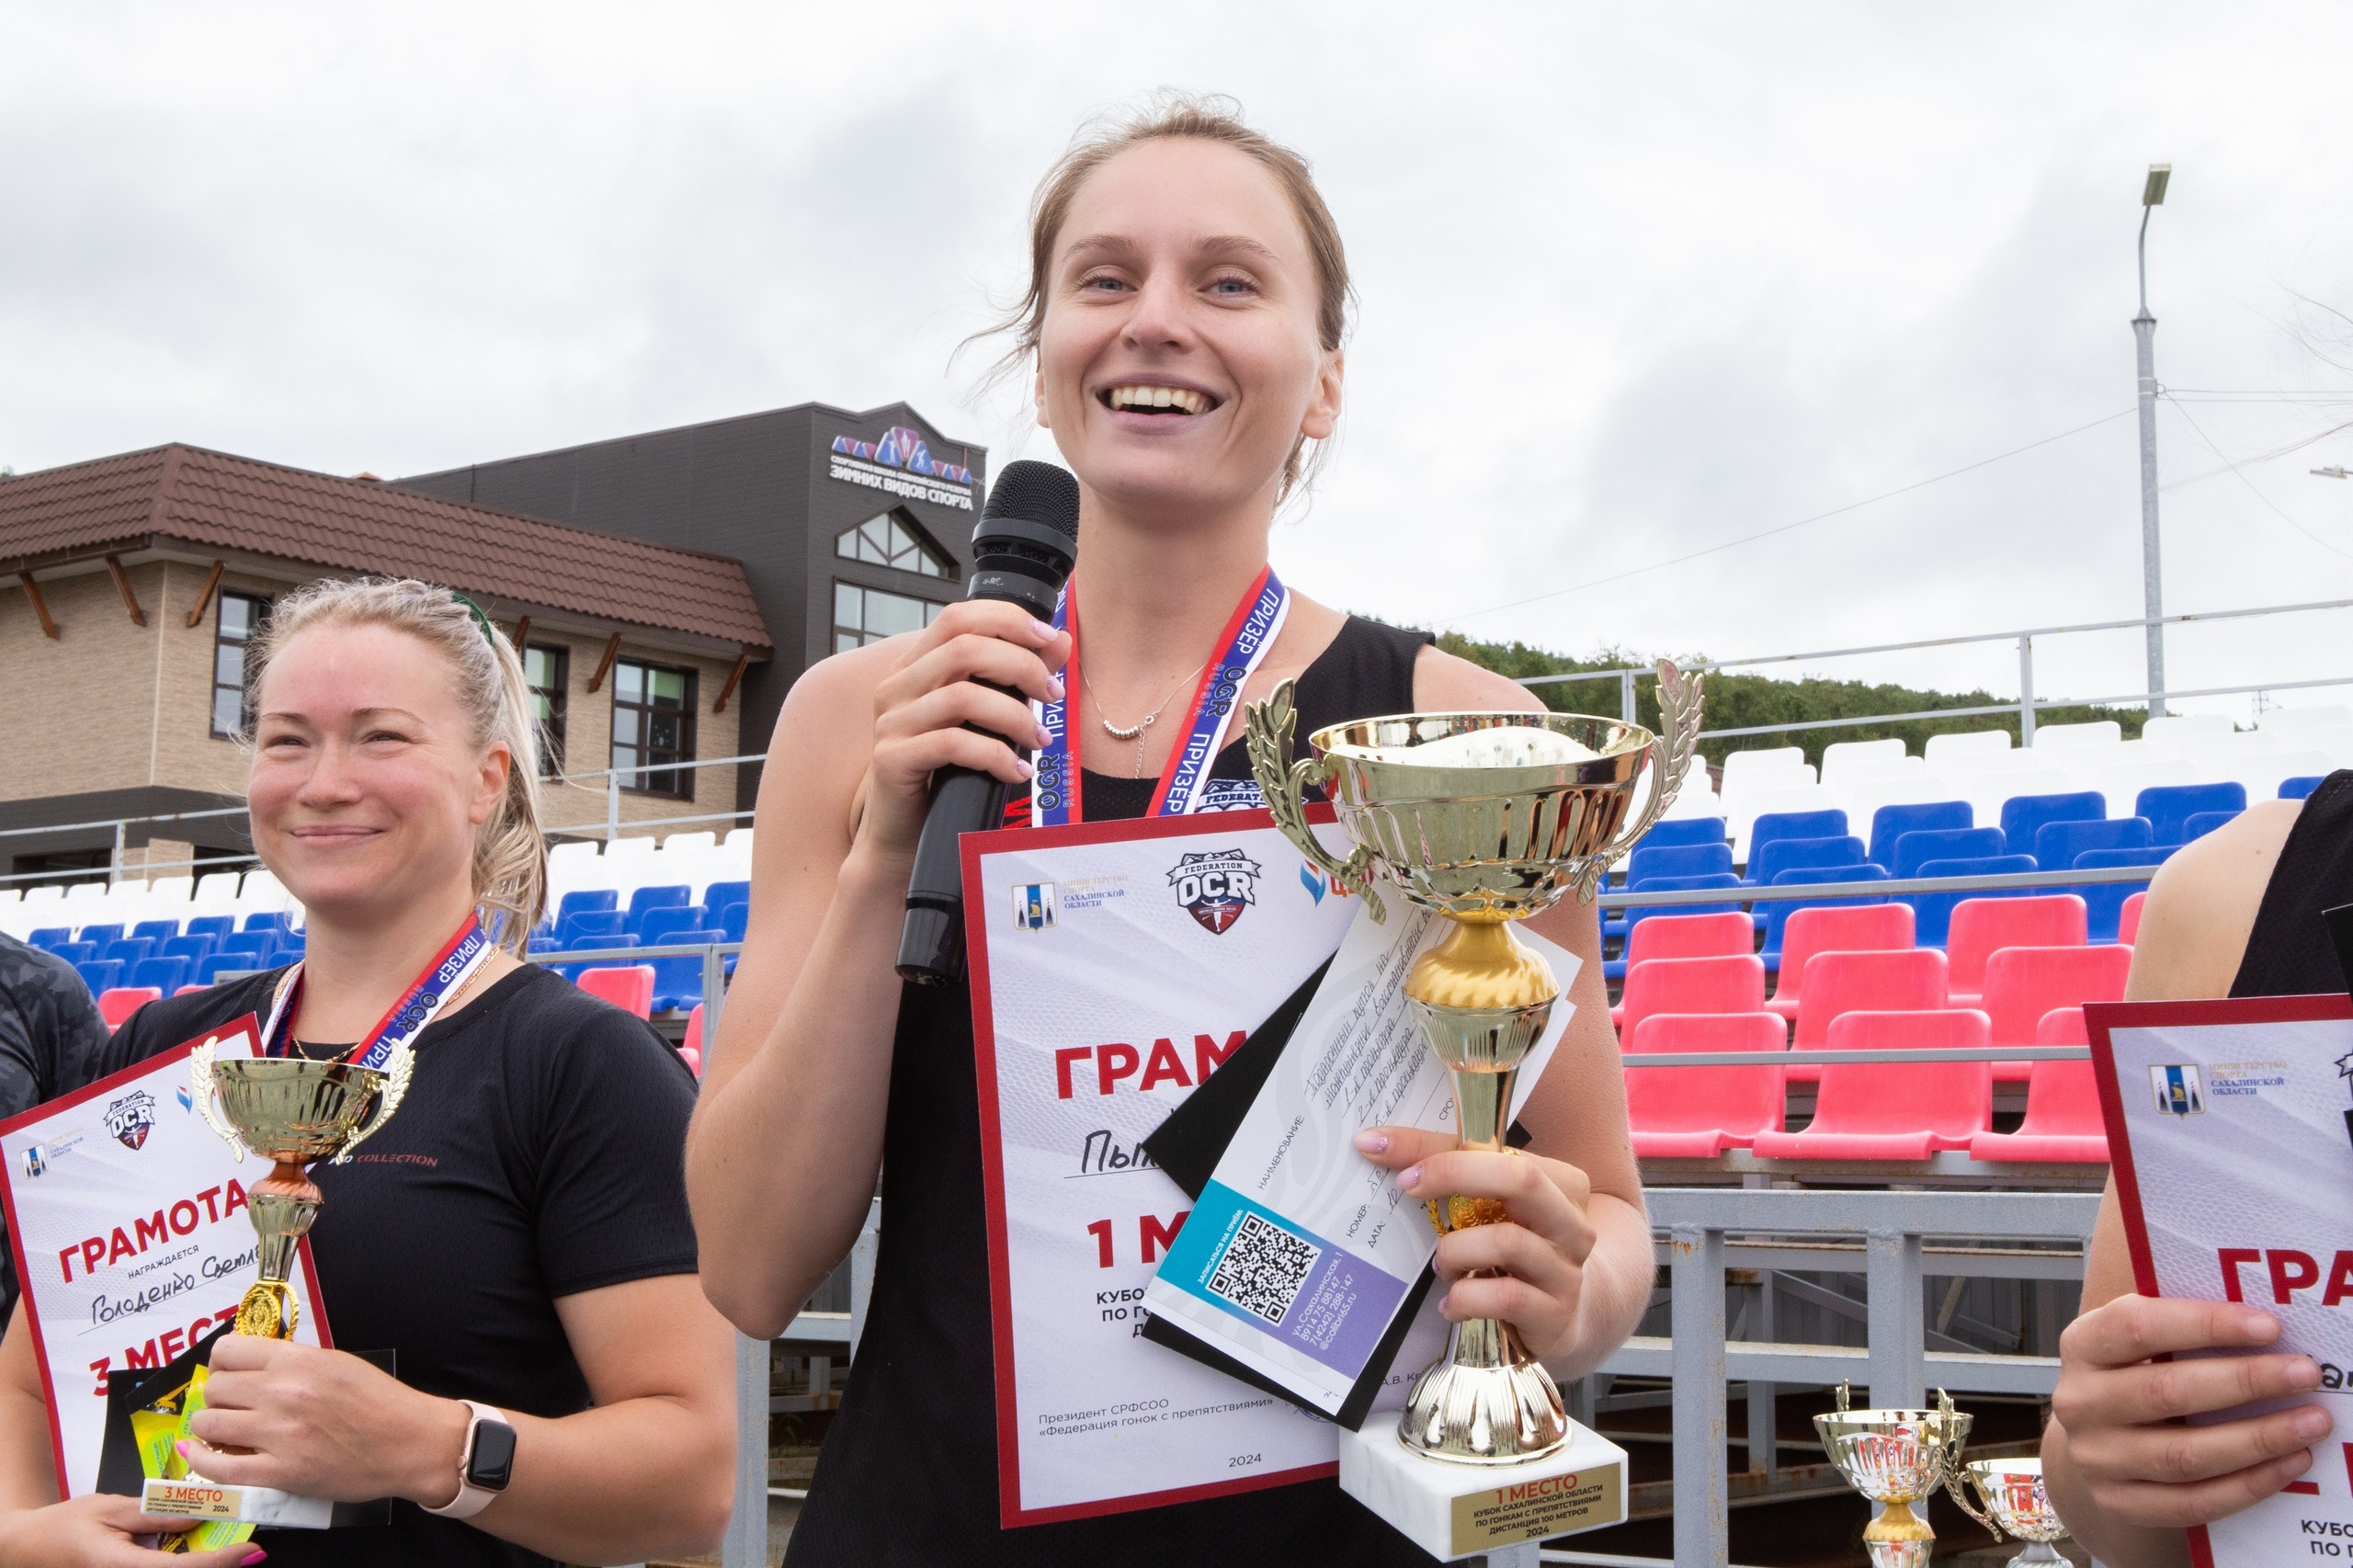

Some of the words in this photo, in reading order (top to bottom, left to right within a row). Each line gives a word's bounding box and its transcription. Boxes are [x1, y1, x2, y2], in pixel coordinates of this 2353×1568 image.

[829, 464, 882, 489] ЗИМНИХ
[882, 478, 926, 499] ВИДОВ
[927, 491, 973, 511] СПОРТА
[1236, 587, 1280, 654] ПРИЗЁР
[1193, 663, 1225, 716] RUSSIA
[1063, 751, 1074, 807] RUSSIA
[1166, 733, 1211, 813] ПРИЗЁР
[1206, 793, 1264, 804] FEDERAT
[1063, 875, 1128, 887] МИНИСТЕРСТВО
[1185, 862, 1243, 874] FEDERATION
[1063, 886, 1095, 894] СПОРТА
[1063, 889, 1125, 902] САХАЛИНСКОЙ
[1064, 900, 1102, 910] ОБЛАСТИ
[1177, 871, 1255, 906] OCR
[438, 935, 480, 983] ПРИЗЁР
[1054, 1029, 1246, 1100] ГРАМ
[2211, 1077, 2285, 1087] САХАЛИНСКОЙ
[2212, 1087, 2257, 1096] ОБЛАСТИ
[110, 1104, 155, 1138] OCR
[112, 1098, 144, 1116] FEDERATION
[357, 1154, 438, 1167] COLLECTION
[1257, 1115, 1305, 1190] НАИМЕНОВАНИЕ:
[59, 1177, 249, 1284] ГРАМОТА
[1347, 1203, 1371, 1238] НОМЕР:
[1368, 1221, 1386, 1248] ДАТА:
[1087, 1219, 1113, 1268] 1
[1198, 1242, 1224, 1284] ЗАПИСАТЬСЯ
[1221, 1233, 1230, 1244] НА
[128, 1244, 199, 1279] НАГРАЖДАЕТСЯ
[92, 1272, 194, 1325] Голоденко
[1097, 1287, 1147, 1304] КУБО
[1301, 1317, 1318, 1341] 8914
[1313, 1305, 1325, 1318] 75
[1321, 1276, 1340, 1304] 88147
[1310, 1312, 1335, 1346] 7(4242)
[1329, 1274, 1353, 1311] 288-147
[1102, 1308, 1128, 1322] ПО
[1320, 1293, 1357, 1350] @colibri65.ru
[89, 1357, 110, 1397] 3
[1039, 1407, 1107, 1425] Президент
[1110, 1398, 1169, 1415] СРФСОО
[1039, 1419, 1118, 1437] «Федерация
[1121, 1415, 1157, 1426] гонок
[1161, 1412, 1168, 1421] с
[1172, 1398, 1274, 1419] препятствиями»
[1228, 1453, 1262, 1468] 2024
[165, 1486, 173, 1498] 3
[176, 1487, 222, 1502] МЕСТО
[1473, 1506, 1501, 1518] КУБОК
[1503, 1491, 1563, 1512] САХАЛИНСКОЙ
[1565, 1484, 1603, 1498] ОБЛАСТИ
[1495, 1489, 1504, 1505] 1
[1509, 1474, 1577, 1502] МЕСТО
[212, 1505, 229, 1513] 2024
[1475, 1518, 1488, 1528] ПО
[1490, 1512, 1523, 1526] ГОНКАМ
[1524, 1508, 1530, 1517] С
[1532, 1494, 1601, 1516] ПРЕПЯТСТВИЯМИ
[1489, 1517, 1540, 1536] ДИСТАНЦИЯ
[1541, 1514, 1554, 1523] 100
[1556, 1506, 1588, 1520] МЕТРОВ
[1526, 1526, 1550, 1539] 2024
[2301, 1519, 2353, 1538] КУБО
[2311, 1540, 2340, 1557] ПО
